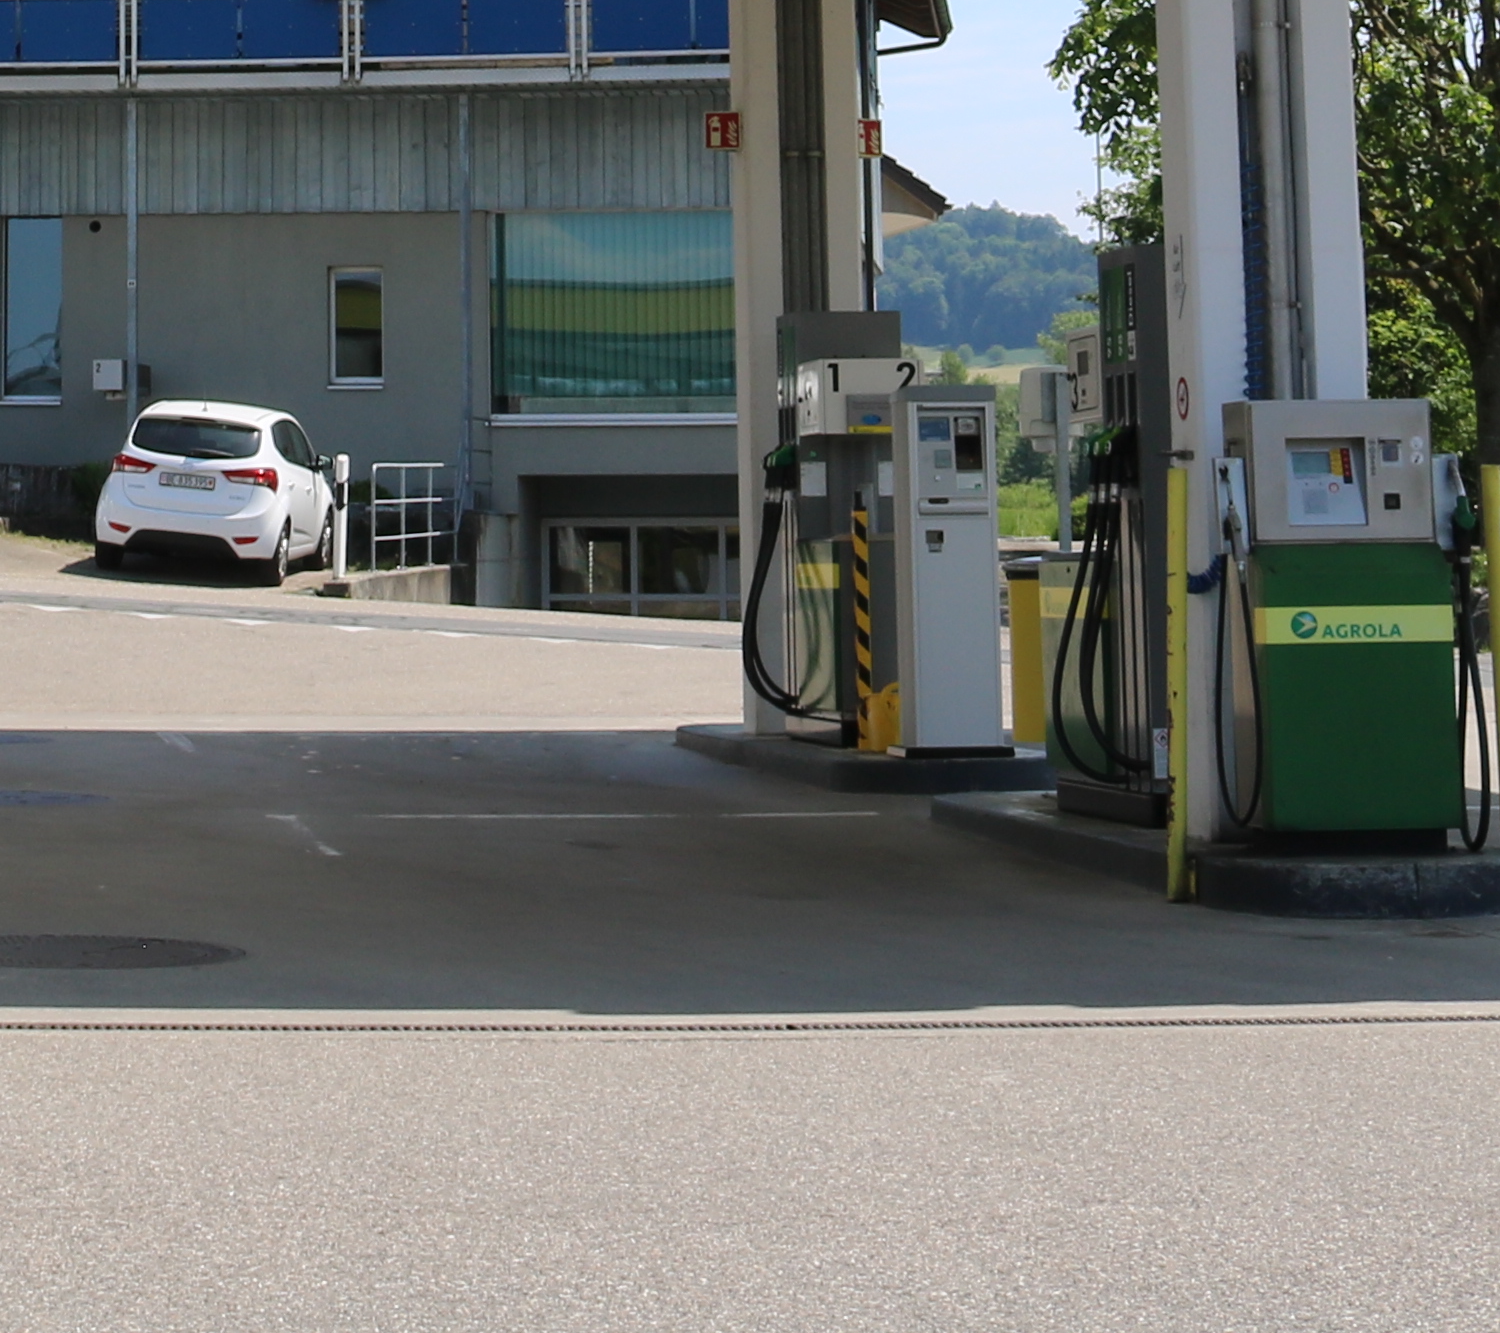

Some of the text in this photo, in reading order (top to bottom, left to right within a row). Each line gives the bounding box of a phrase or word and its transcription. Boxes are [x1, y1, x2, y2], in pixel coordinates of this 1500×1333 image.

[827, 363, 840, 393] 1
[896, 362, 917, 389] 2
[1321, 623, 1403, 639] AGROLA
